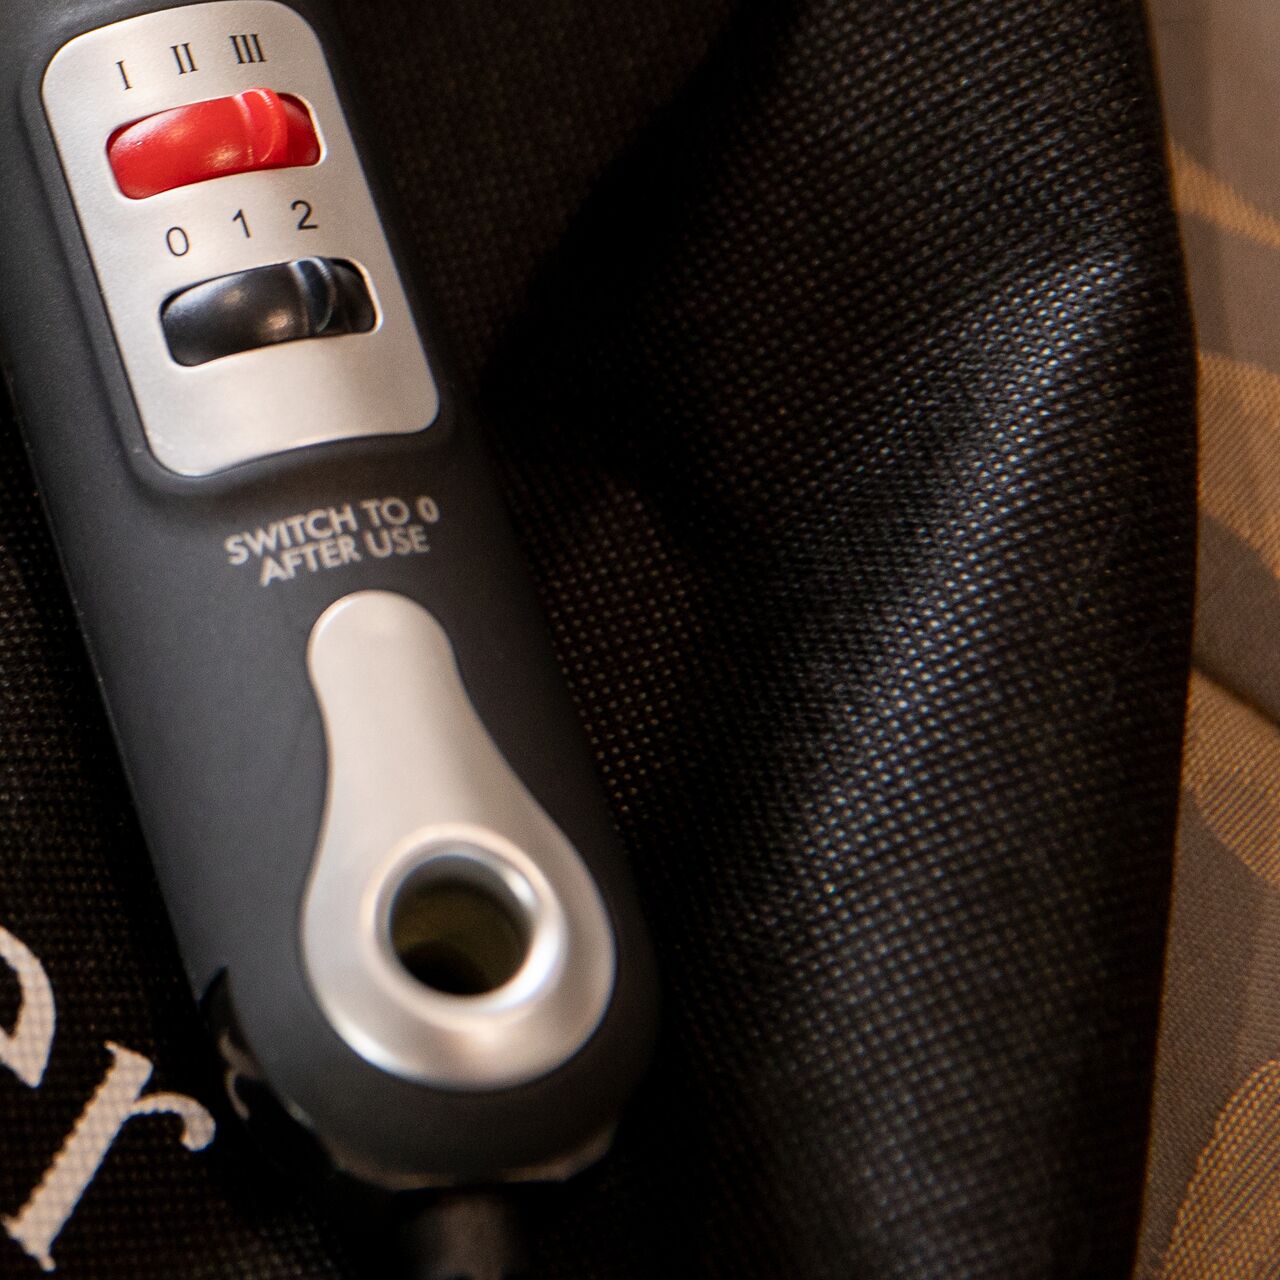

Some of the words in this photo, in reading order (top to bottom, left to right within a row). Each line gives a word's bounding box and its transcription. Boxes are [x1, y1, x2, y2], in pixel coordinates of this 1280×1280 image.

[166, 226, 190, 256] 0
[231, 209, 251, 238] 1
[291, 200, 318, 230] 2
[224, 502, 358, 565] SWITCH
[360, 496, 410, 527] TO
[259, 535, 362, 587] AFTER
[363, 525, 430, 558] USE
